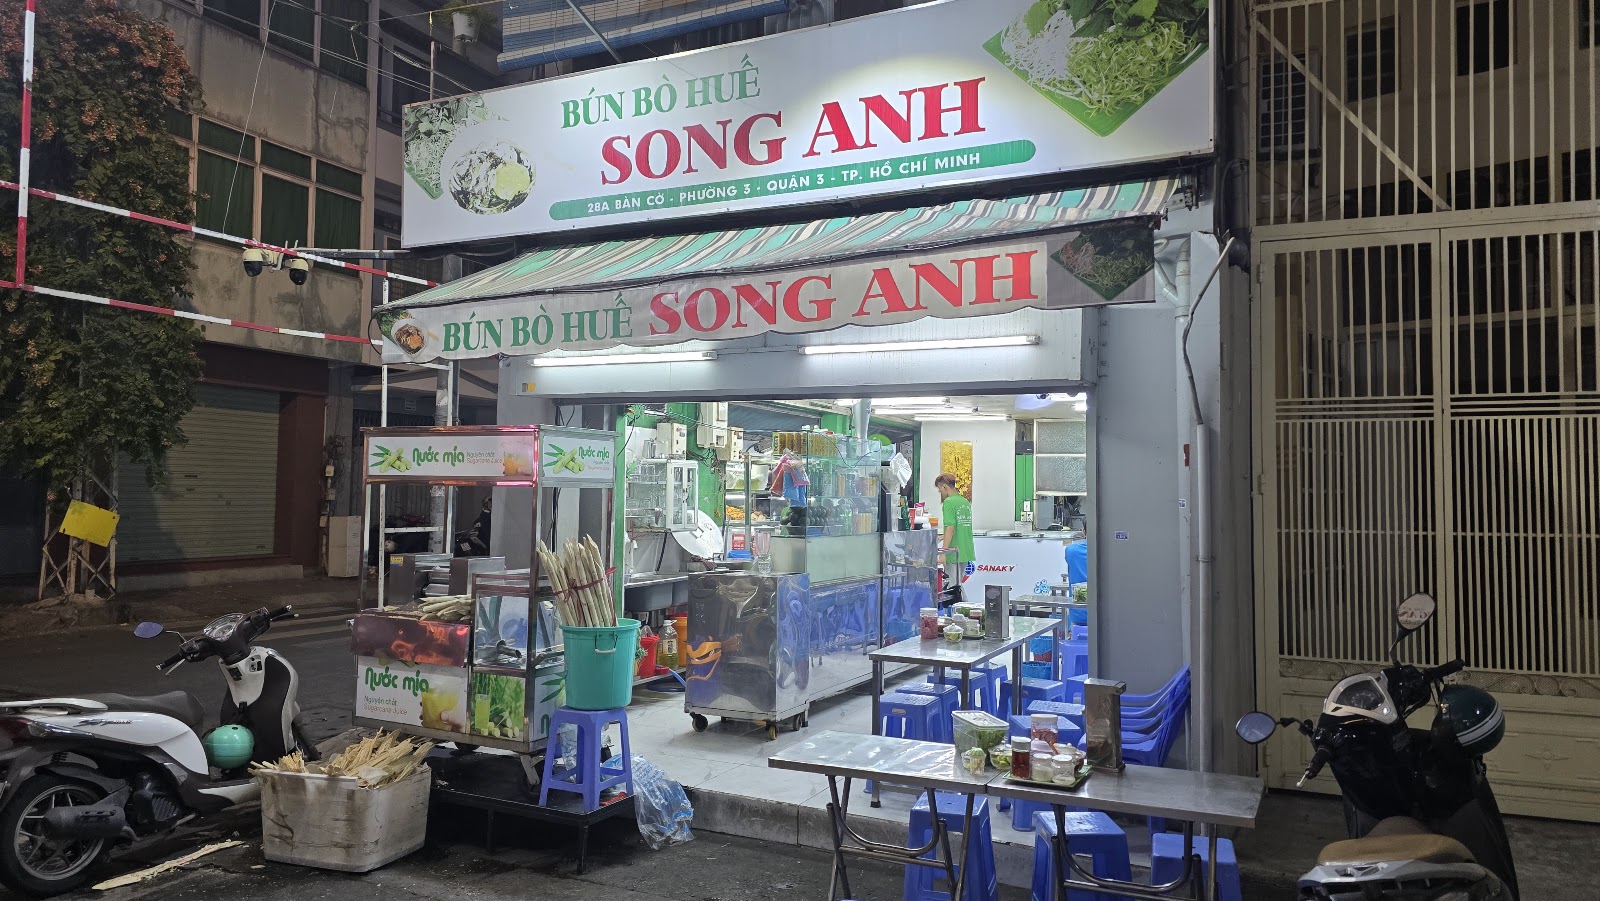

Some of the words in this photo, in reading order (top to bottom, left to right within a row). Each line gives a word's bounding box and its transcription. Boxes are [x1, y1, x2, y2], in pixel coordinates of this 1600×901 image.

[561, 86, 624, 129] BÚN
[632, 74, 677, 116] BÒ
[686, 52, 760, 108] HUẾ
[600, 110, 787, 186] SONG
[802, 76, 985, 158] ANH
[587, 201, 609, 214] 28A
[615, 194, 641, 211] BÀN
[644, 190, 665, 207] CỜ
[679, 185, 738, 202] PHƯỜNG
[743, 183, 751, 195] 3
[767, 175, 810, 193] QUẬN
[816, 175, 825, 186] 3
[841, 168, 863, 182] TP.
[869, 161, 893, 178] HỒ
[899, 158, 928, 174] CHÍ
[934, 152, 981, 168] MINH
[442, 312, 503, 352] BÚN
[510, 304, 553, 347] BÒ
[561, 292, 633, 342] HUẾ
[649, 275, 837, 336] SONG
[852, 250, 1040, 318] ANH
[412, 445, 439, 466] Nước
[442, 445, 465, 467] mía
[977, 564, 1015, 572] SANAKY
[365, 666, 398, 692] Nước
[403, 670, 429, 697] mía
